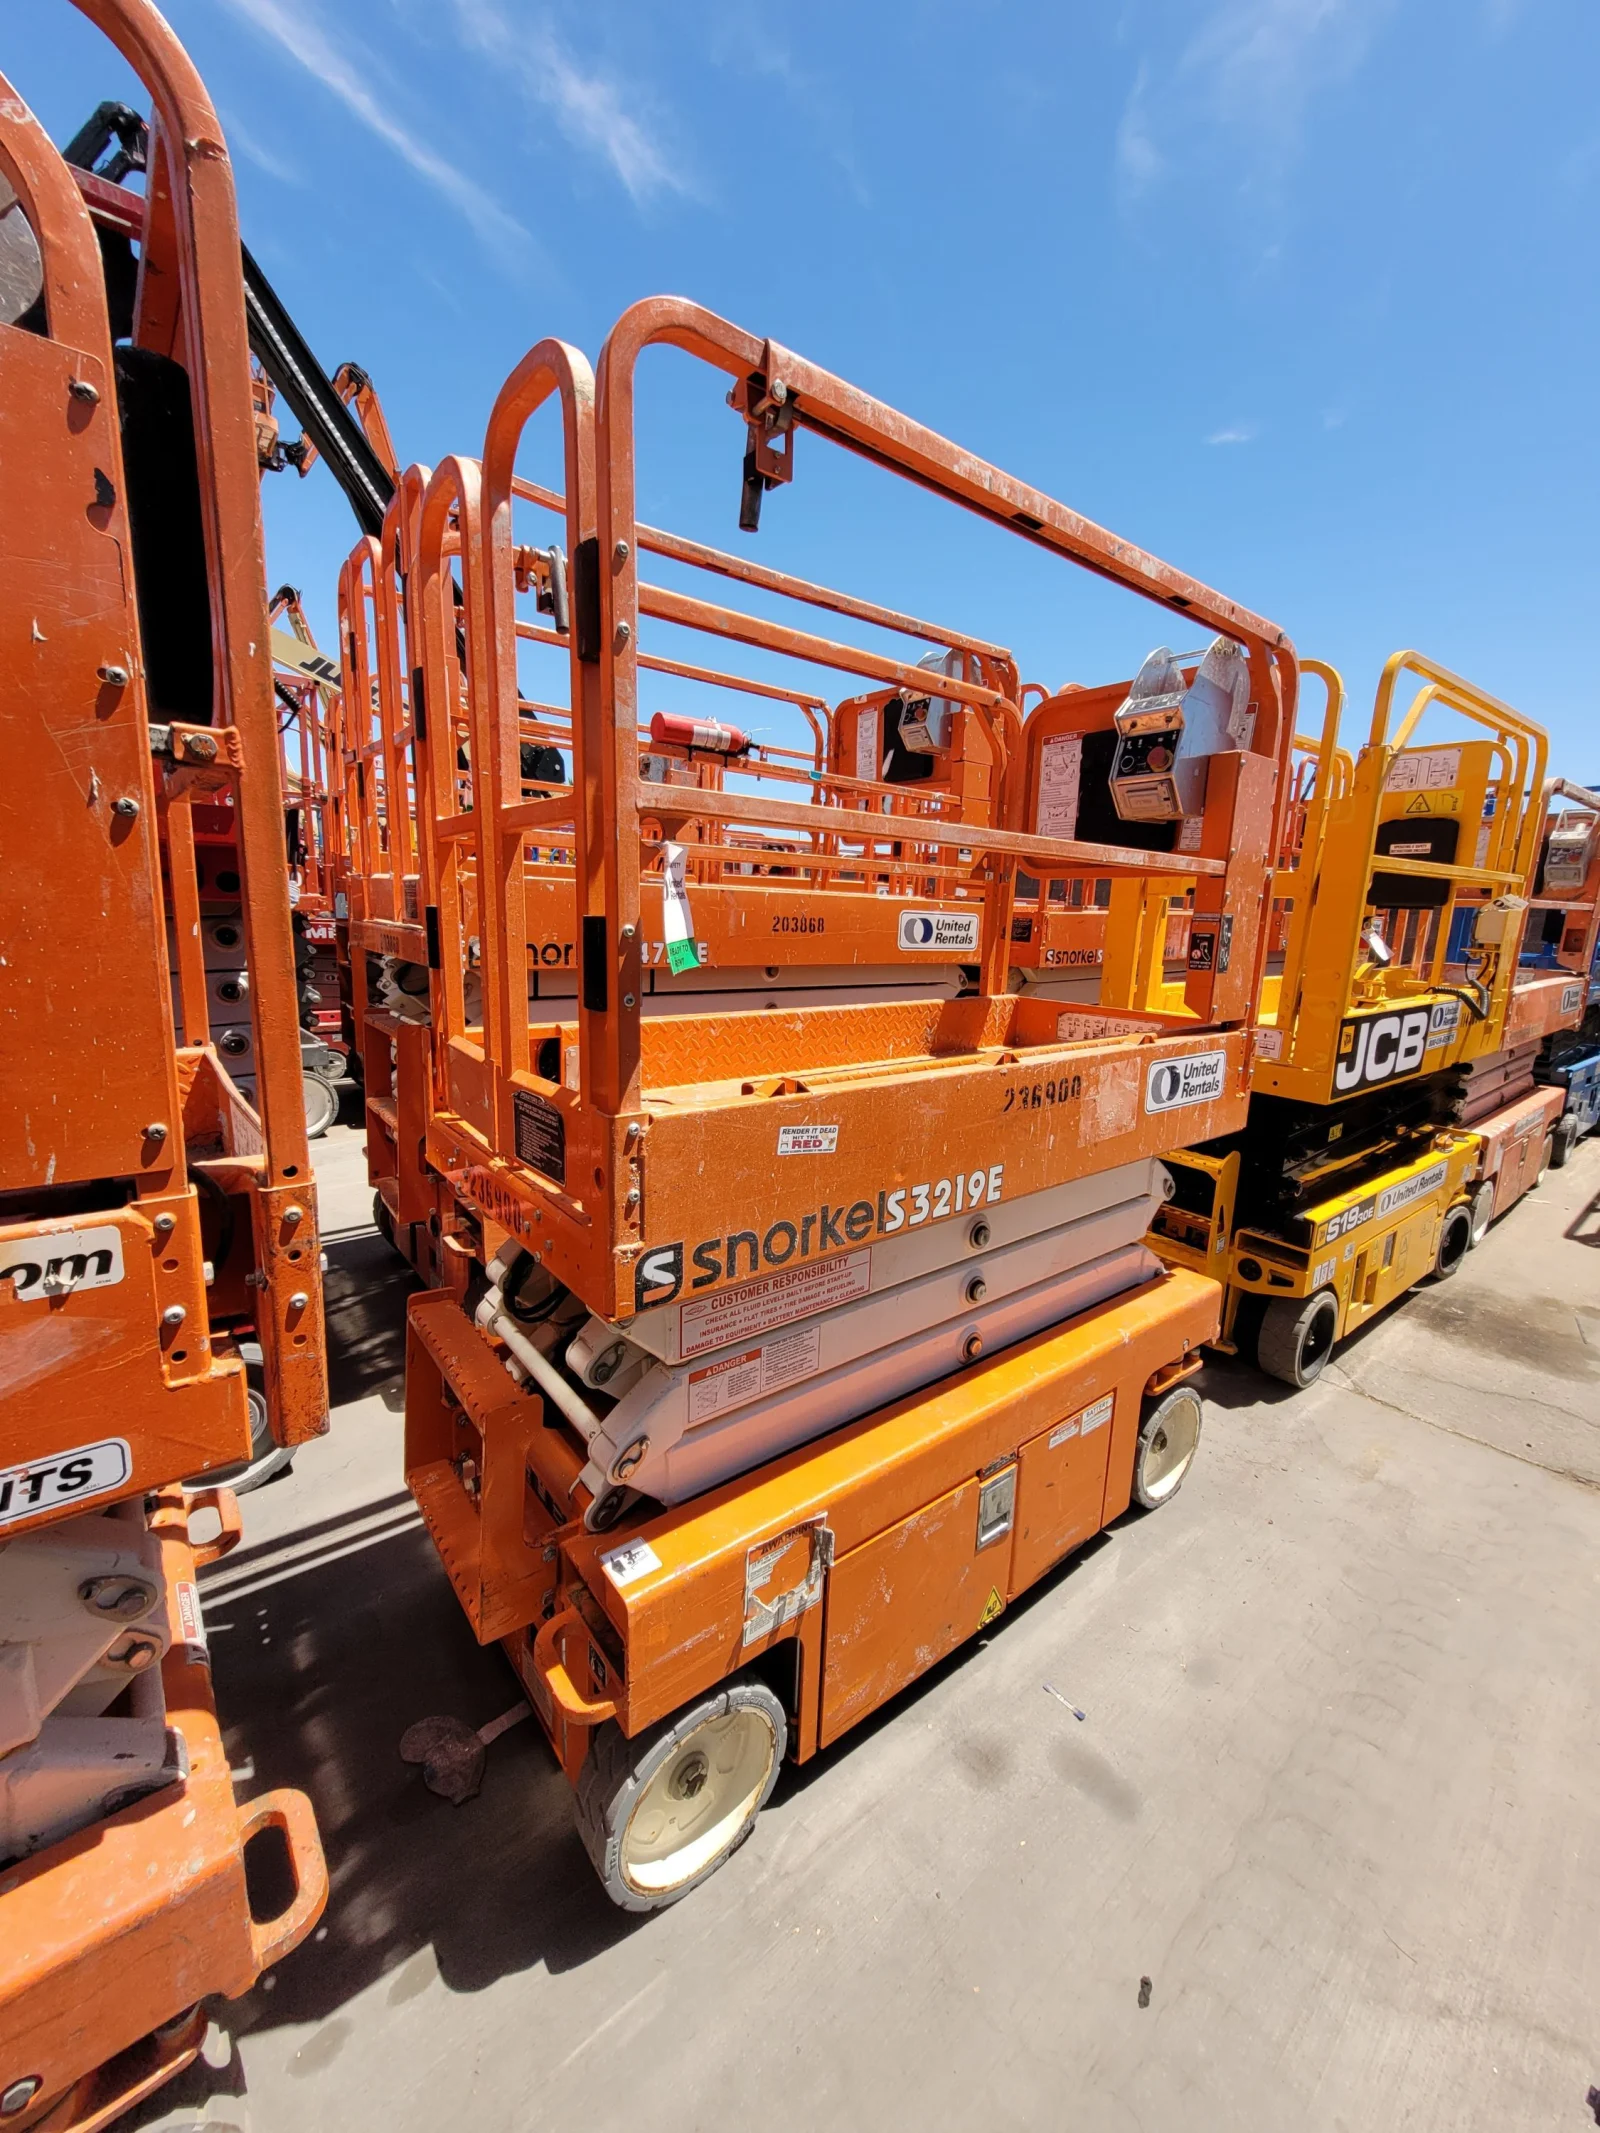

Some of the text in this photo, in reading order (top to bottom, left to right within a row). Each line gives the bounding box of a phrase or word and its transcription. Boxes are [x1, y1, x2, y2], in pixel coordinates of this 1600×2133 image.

[771, 915, 825, 933] 203868
[934, 932, 973, 945] Rentals
[935, 919, 971, 932] United
[1055, 949, 1098, 965] snorkel
[1336, 1012, 1429, 1090] JCB
[1183, 1058, 1220, 1080] United
[1003, 1075, 1082, 1112] 236900
[1181, 1076, 1220, 1099] Rentals
[791, 1139, 823, 1149] RED
[1392, 1168, 1444, 1208] United Rentals
[692, 1190, 886, 1289] snorkel
[885, 1164, 1005, 1234] S3219E
[711, 1256, 849, 1310] CUSTOMER RESPONSIBILITY
[700, 1279, 856, 1338] INSURANCE FLAT TIRES TIRE DAMAGE REFUELING
[705, 1271, 853, 1326] CHECK ALL FLUID LEVELS DAILY BEFORE START-UP
[686, 1339, 714, 1354] DAMAGE
[715, 1333, 724, 1342] TO
[725, 1321, 762, 1340] EQUIPMENT
[767, 1312, 794, 1325] BATTERY
[795, 1296, 834, 1315] MAINTENANCE
[839, 1285, 865, 1300] CLEANING
[711, 1355, 748, 1374] DANGER
[180, 1591, 193, 1621] DANGER
